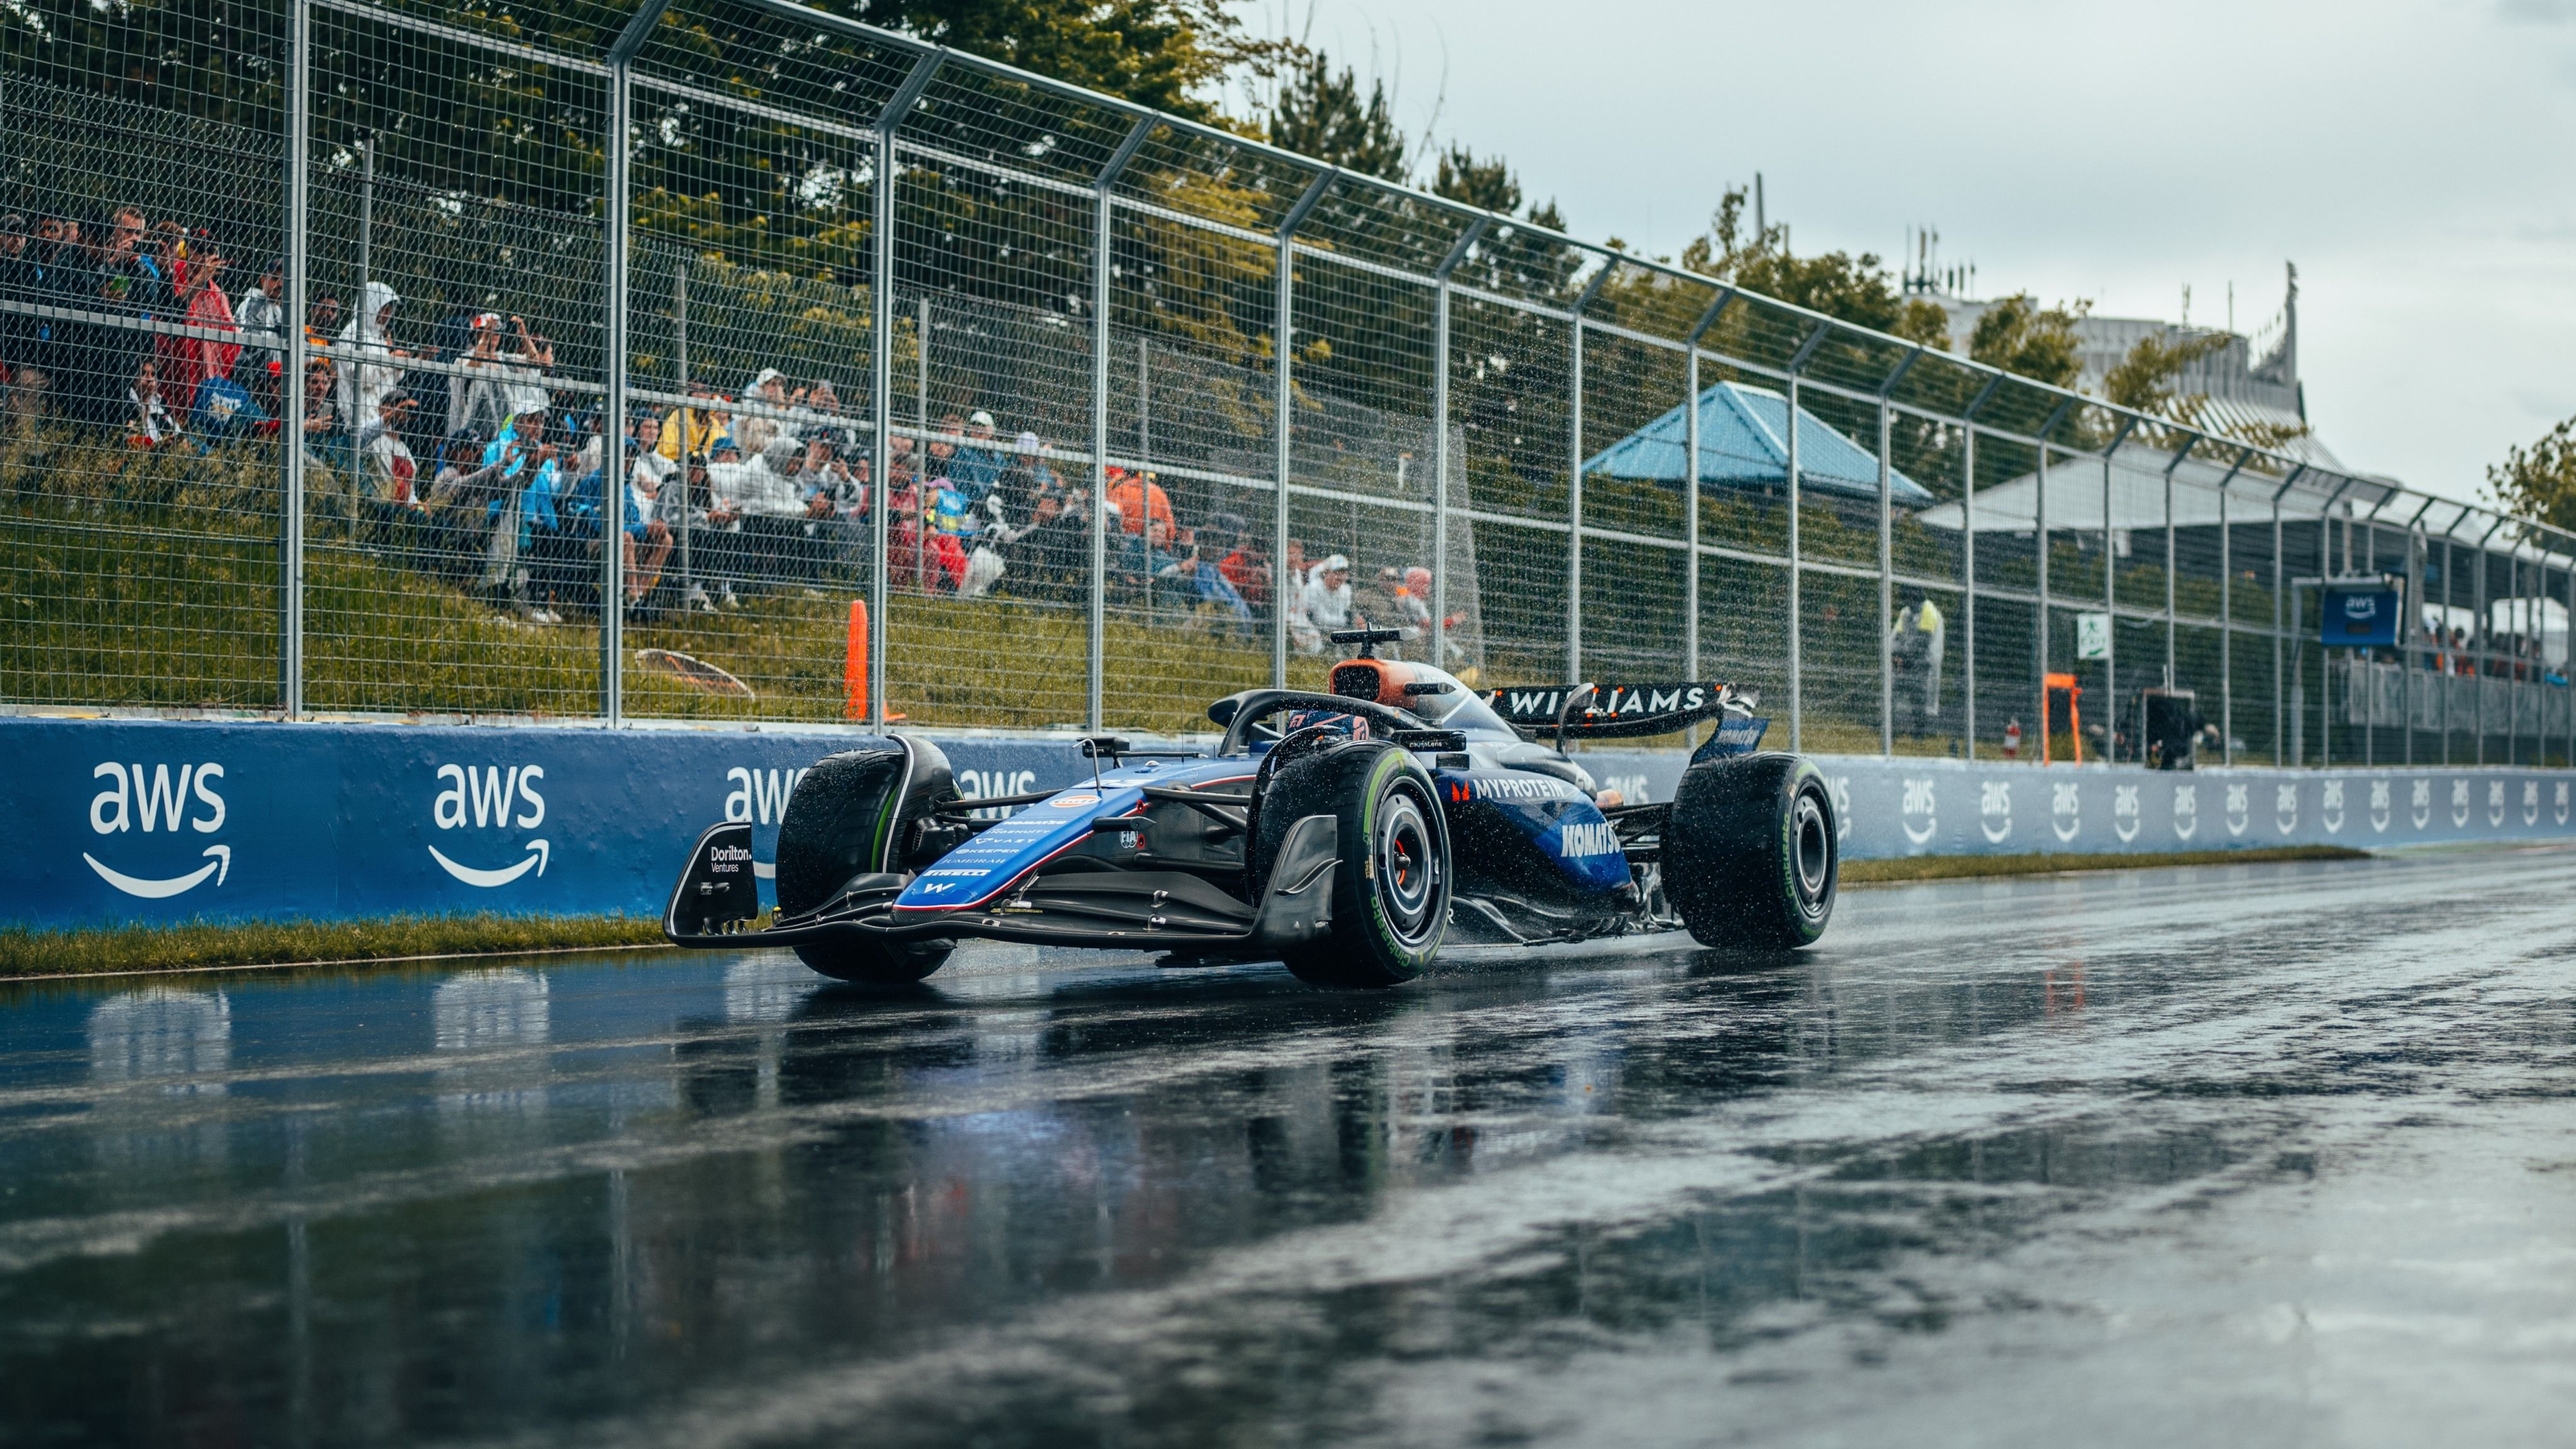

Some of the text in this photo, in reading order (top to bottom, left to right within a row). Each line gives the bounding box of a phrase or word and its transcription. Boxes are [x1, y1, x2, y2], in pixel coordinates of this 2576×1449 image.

[90, 761, 226, 835] aws
[434, 763, 546, 830] aws
[1473, 779, 1565, 799] MYPROTEIN
[711, 862, 739, 873] Ventures
[1370, 896, 1412, 968] Cinturato
